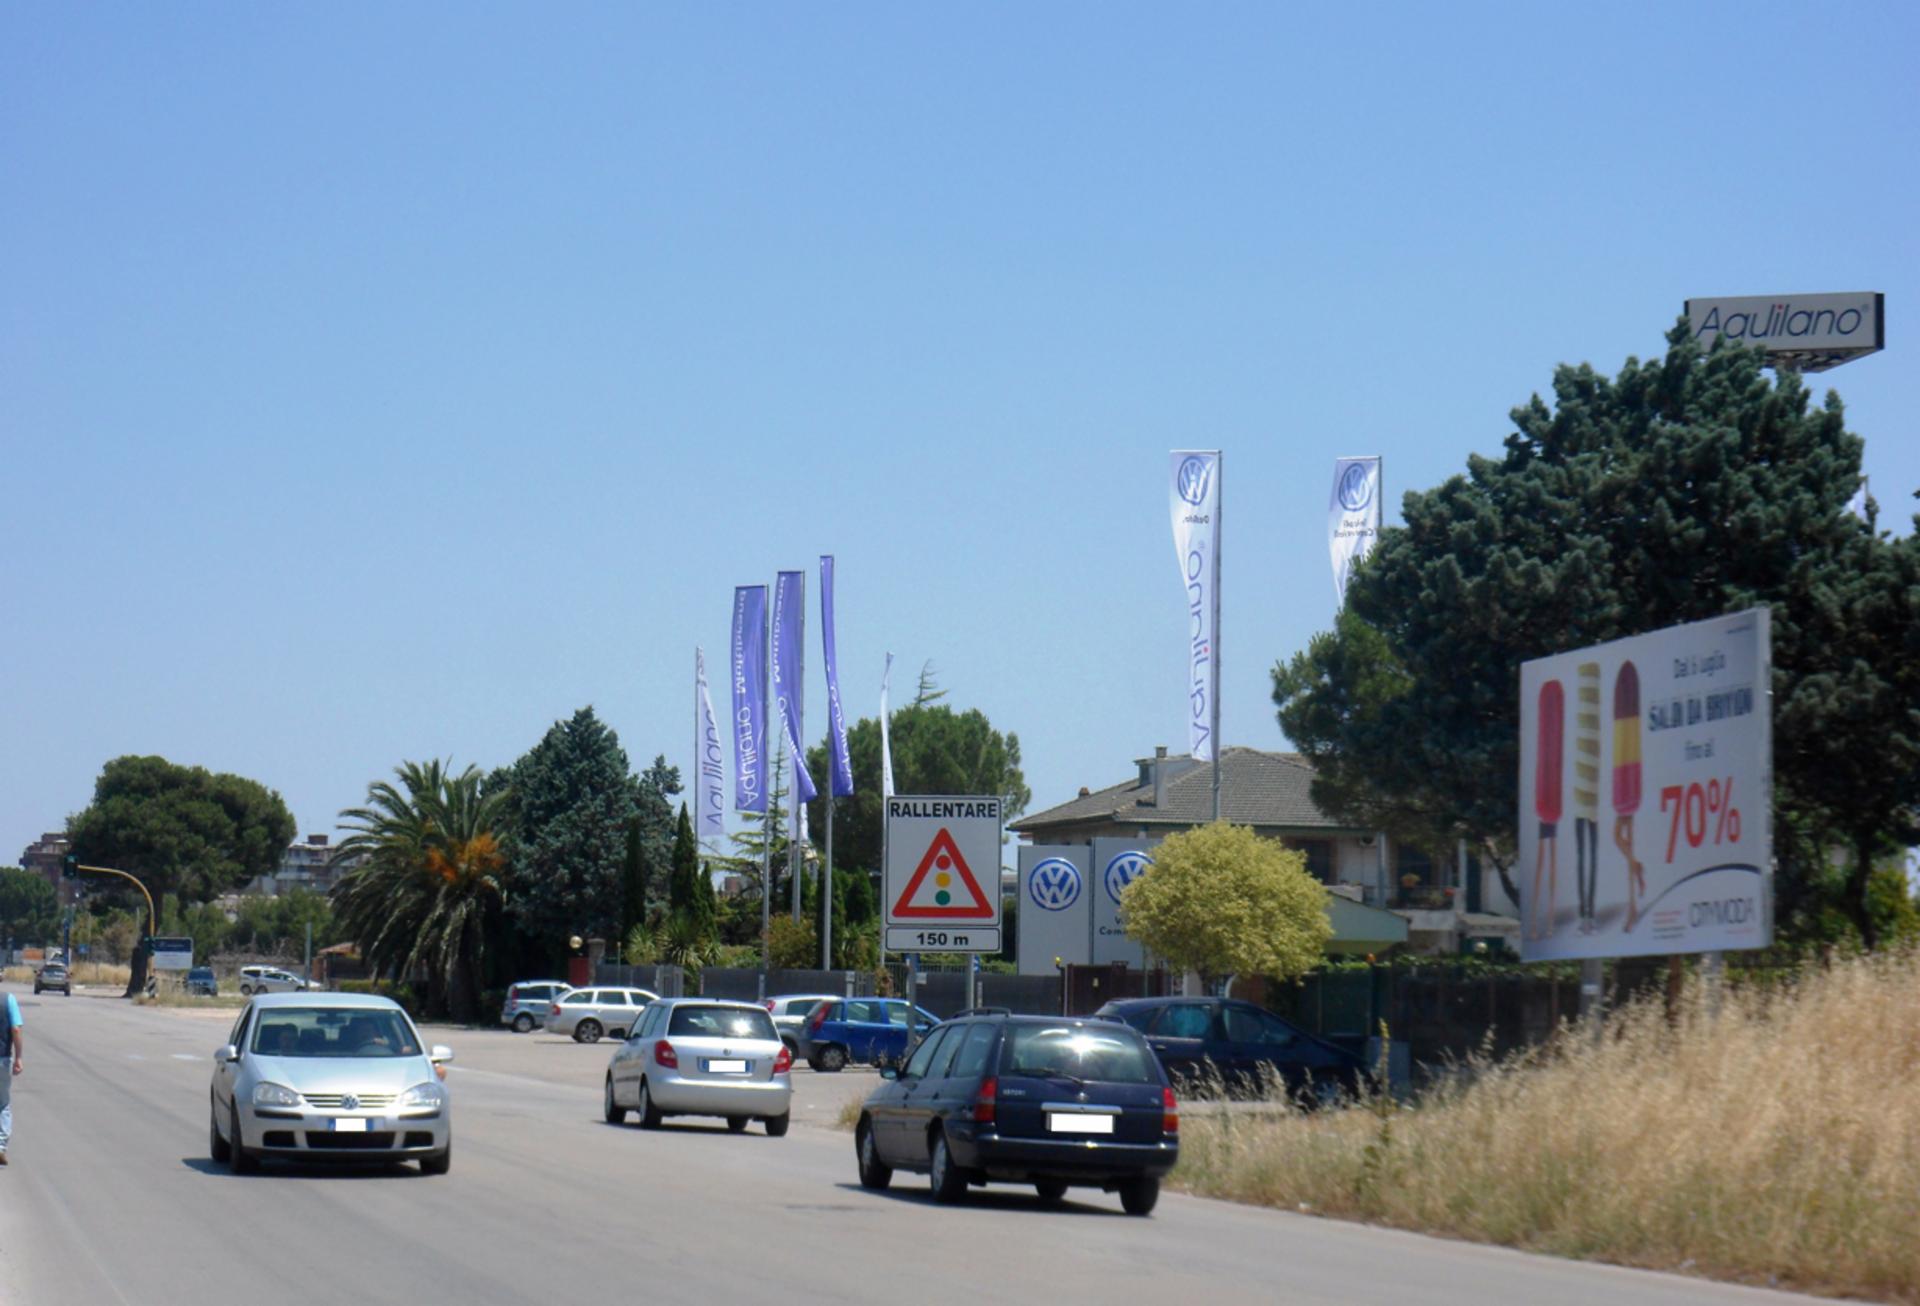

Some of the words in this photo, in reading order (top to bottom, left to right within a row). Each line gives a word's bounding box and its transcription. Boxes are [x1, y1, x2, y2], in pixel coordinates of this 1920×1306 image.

[890, 802, 998, 818] RALLENTARE
[1661, 776, 1742, 864] 70%
[917, 933, 948, 946] 150
[953, 936, 969, 946] m
